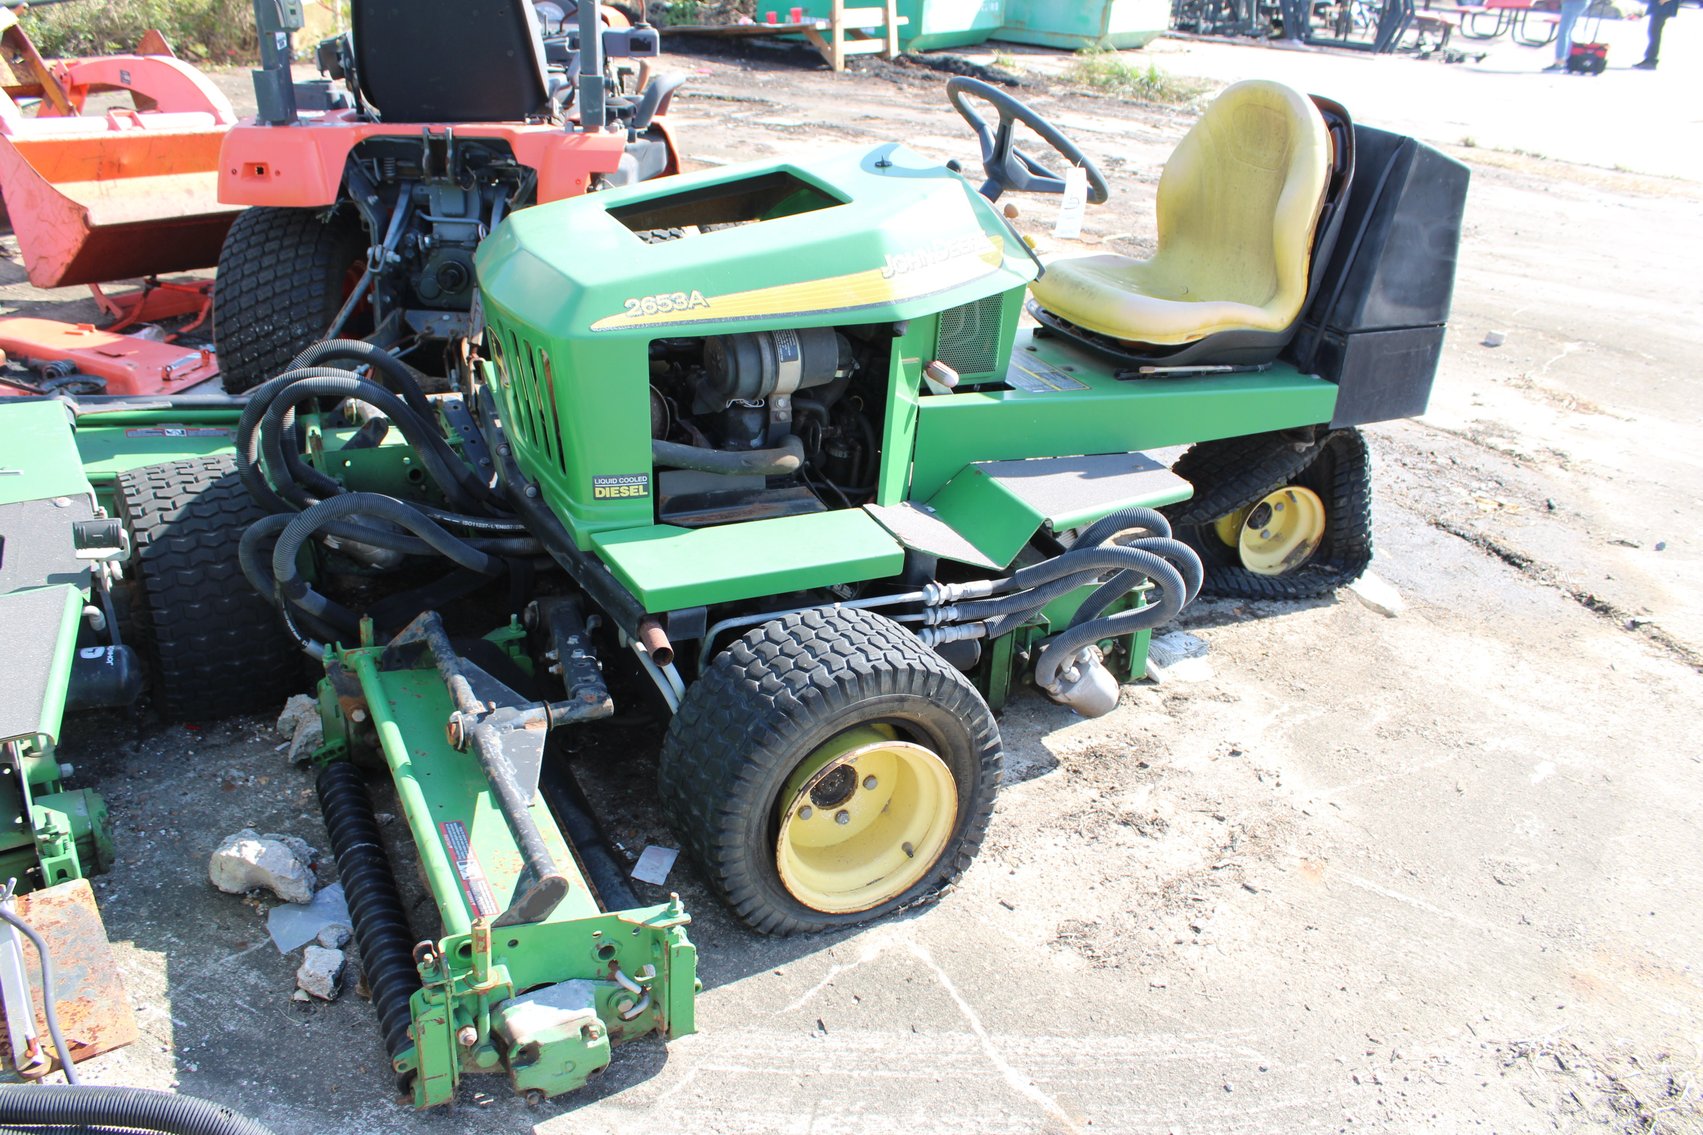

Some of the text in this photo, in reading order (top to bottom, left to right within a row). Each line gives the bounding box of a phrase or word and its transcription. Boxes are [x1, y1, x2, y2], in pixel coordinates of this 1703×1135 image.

[624, 289, 710, 317] 2653A
[619, 475, 648, 484] COOLED
[595, 485, 648, 498] DIESEL
